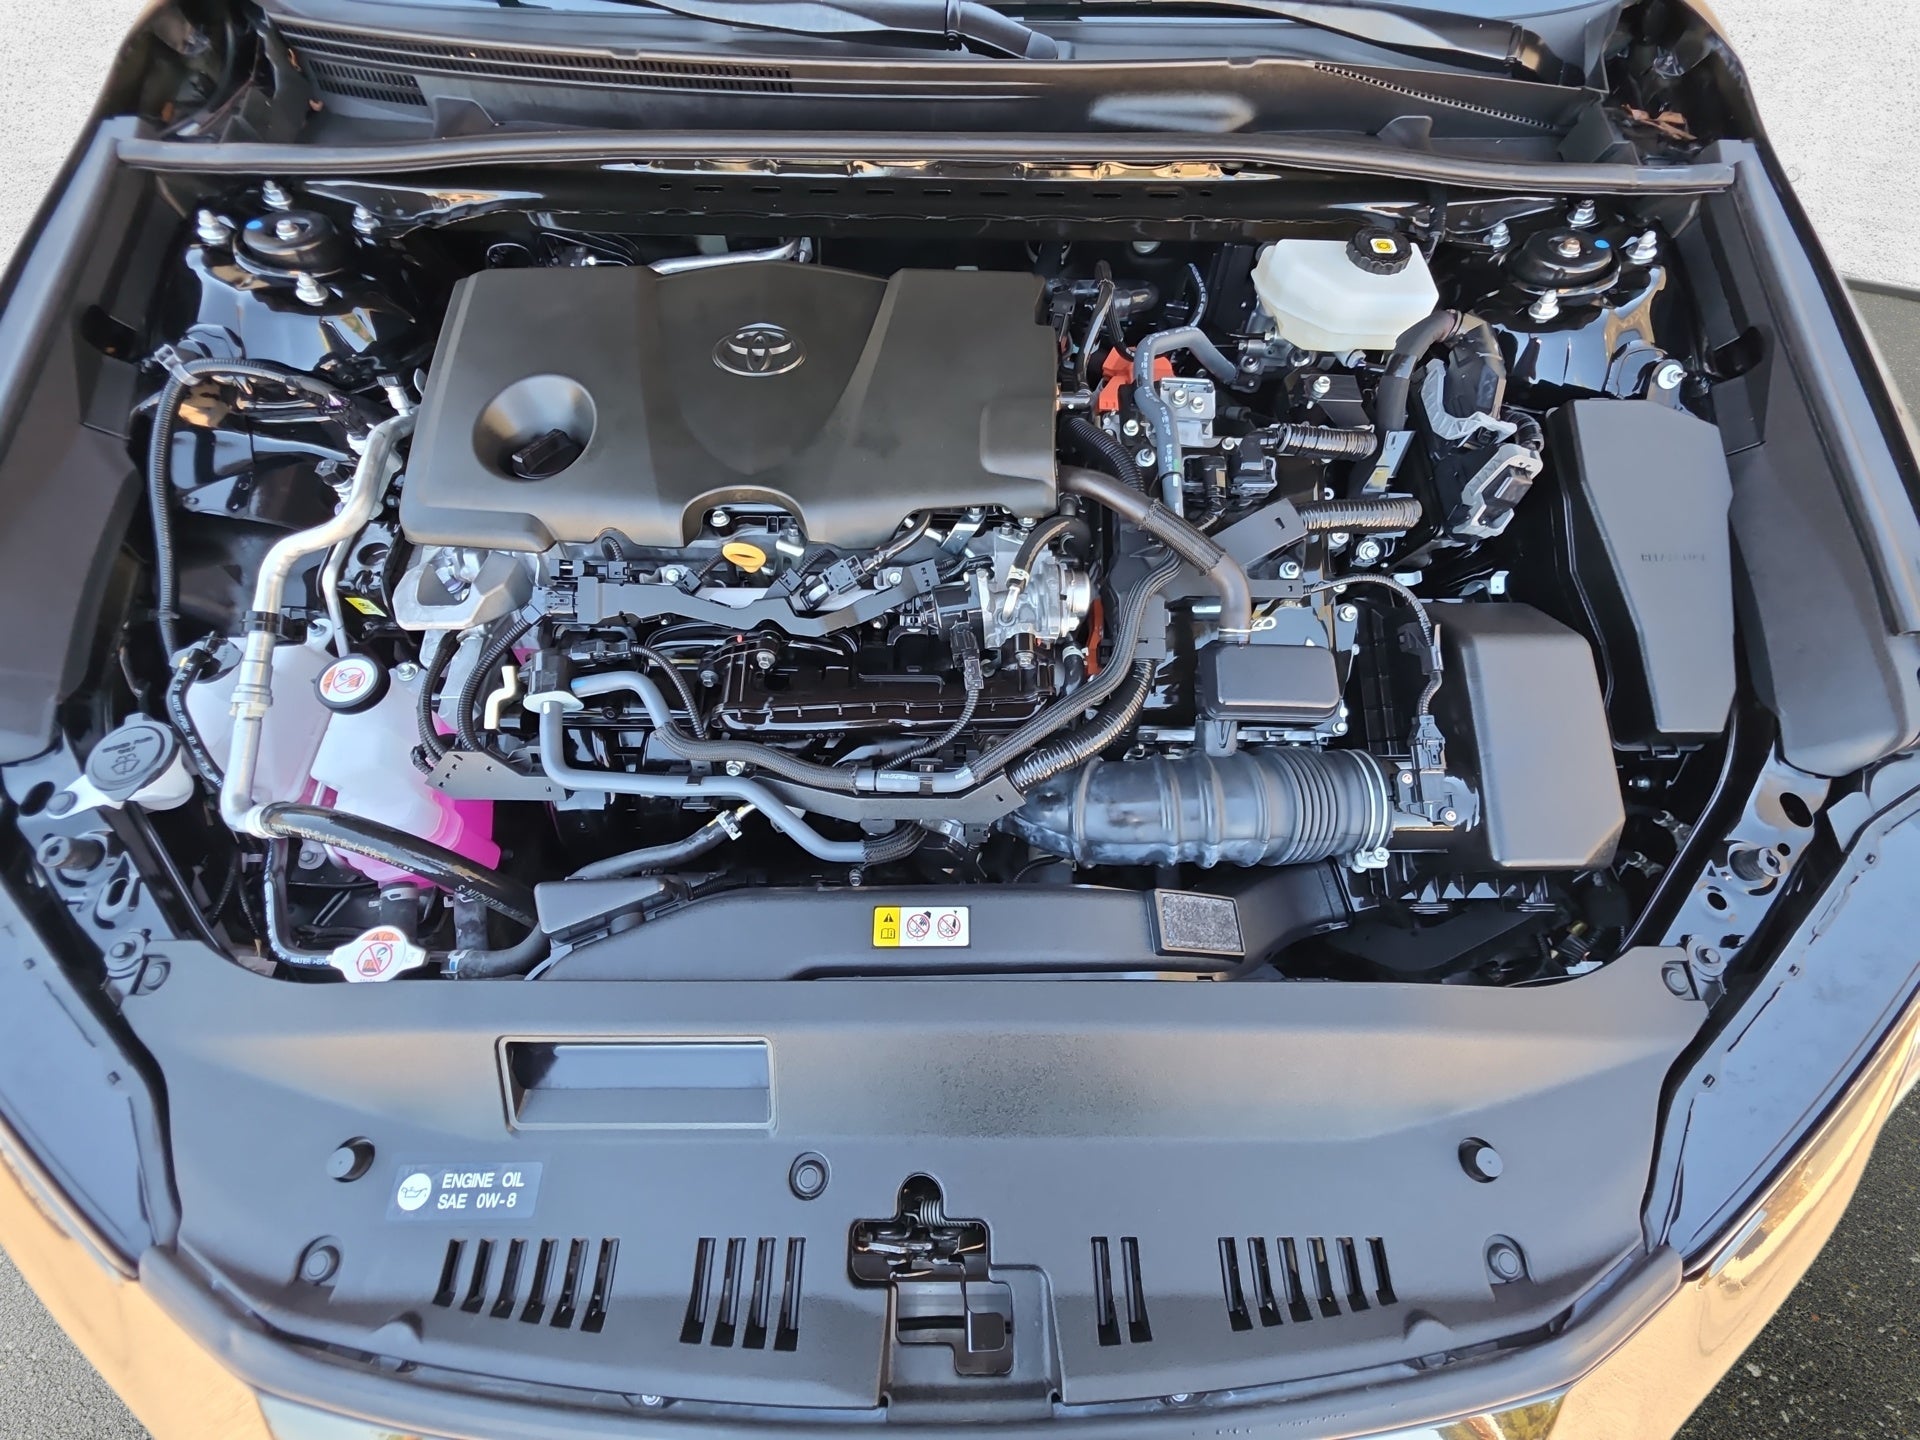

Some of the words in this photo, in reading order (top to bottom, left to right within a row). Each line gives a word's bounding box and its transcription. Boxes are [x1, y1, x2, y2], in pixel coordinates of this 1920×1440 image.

[442, 1172, 495, 1189] ENGINE
[502, 1172, 525, 1188] OIL
[437, 1193, 468, 1209] SAE
[476, 1192, 517, 1209] 0W-8
